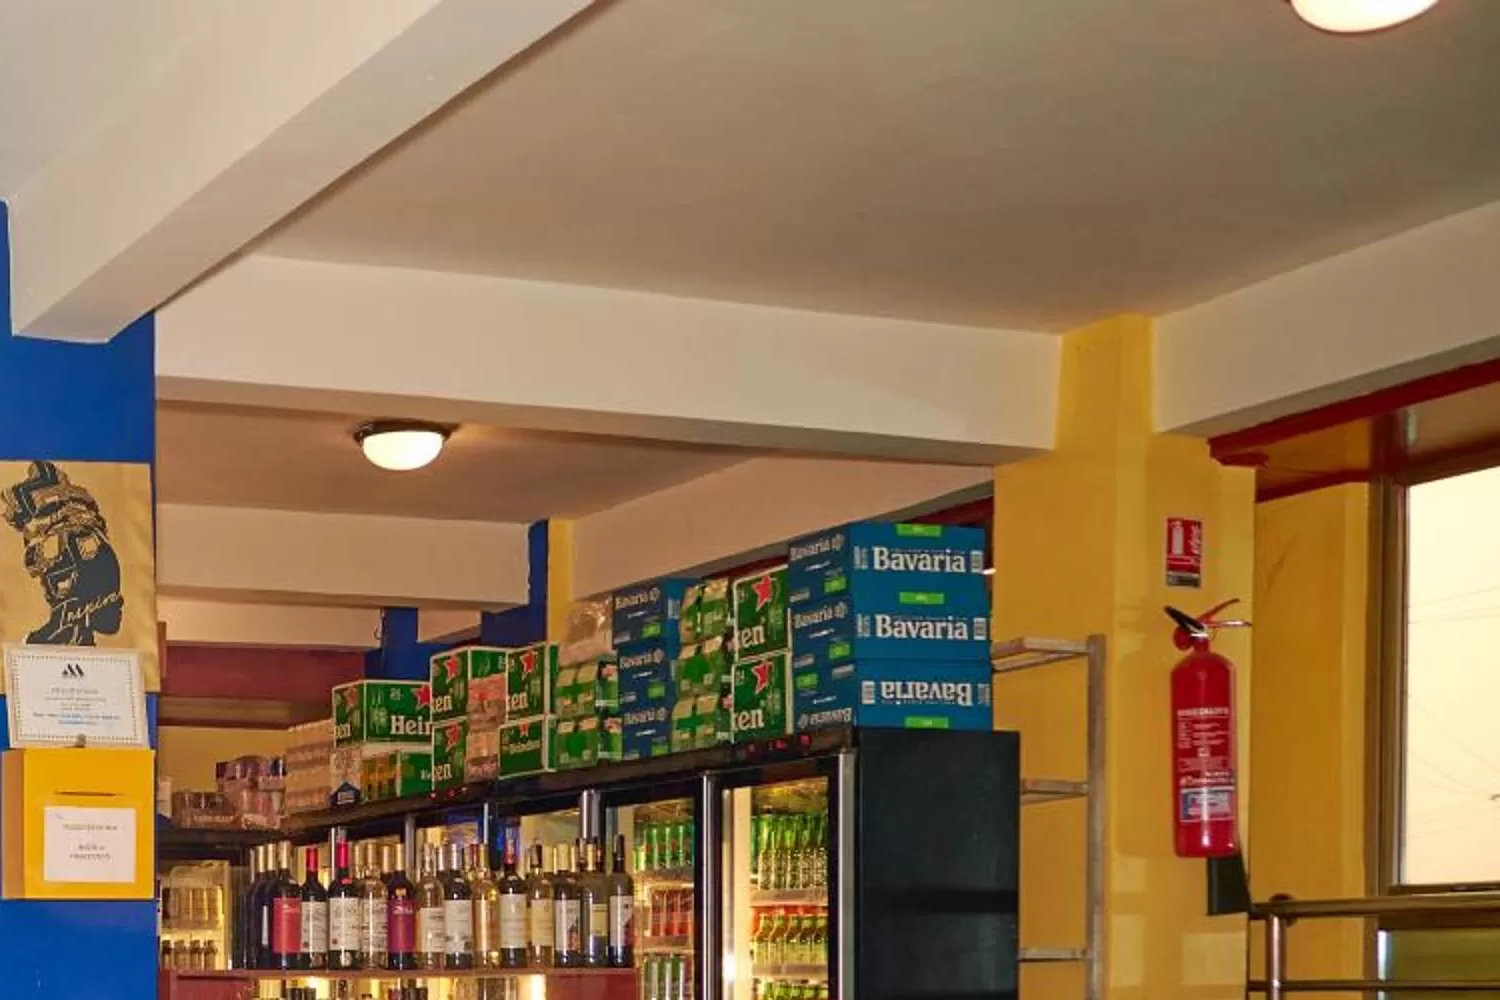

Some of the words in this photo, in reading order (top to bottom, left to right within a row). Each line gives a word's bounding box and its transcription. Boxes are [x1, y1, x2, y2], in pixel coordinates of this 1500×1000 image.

[872, 547, 966, 573] Bavaria
[875, 614, 968, 640] Bavaria
[881, 681, 974, 706] Bavaria
